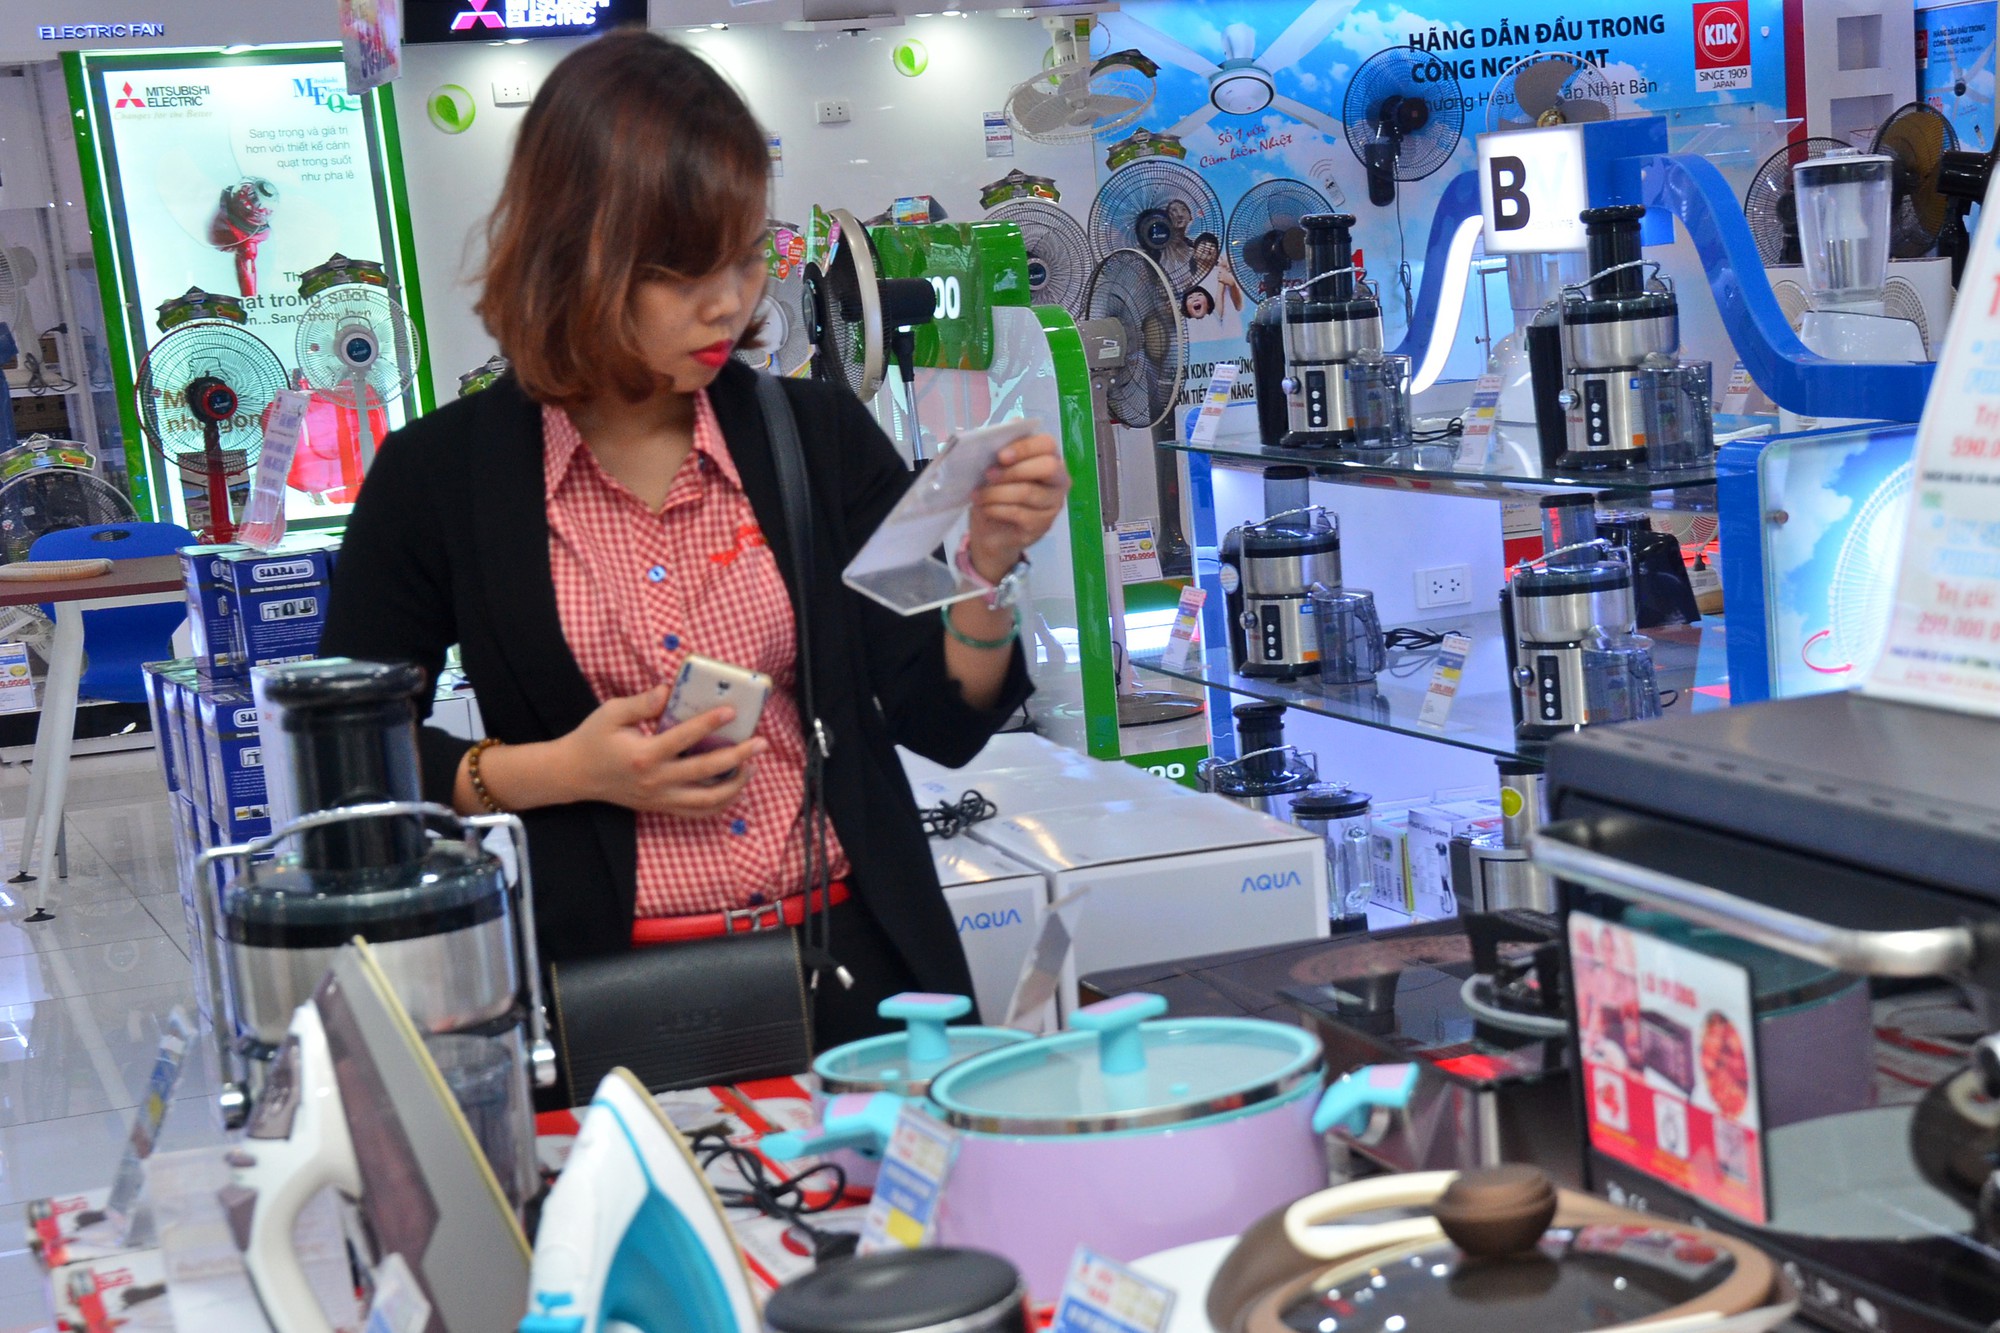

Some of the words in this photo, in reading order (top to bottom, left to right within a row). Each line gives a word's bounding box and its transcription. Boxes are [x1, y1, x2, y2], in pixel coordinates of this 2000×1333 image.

[39, 24, 127, 40] ELECTRIC
[129, 23, 165, 37] FAN
[1409, 27, 1476, 52] HÃNG
[1482, 18, 1530, 48] DẪN
[1535, 16, 1582, 43] ĐẦU
[1588, 14, 1666, 39] TRONG
[1705, 23, 1738, 46] KDK
[1411, 56, 1476, 83] CÔNG
[1700, 70, 1725, 81] SINCE
[1728, 68, 1748, 79] 1909
[146, 85, 210, 97] MITSUBISHI
[1589, 80, 1625, 98] Nhật
[1630, 78, 1658, 94] Bản
[1713, 80, 1736, 89] JAPAN
[148, 96, 203, 108] ELECTRIC
[249, 129, 276, 140] Sang
[278, 128, 304, 139] trọng
[307, 127, 319, 136] và
[321, 127, 336, 138] giá
[339, 126, 348, 136] trị
[1236, 128, 1242, 139] 1
[246, 144, 266, 154] hơn
[269, 143, 285, 153] với
[287, 141, 308, 152] thiết
[311, 140, 323, 151] kế
[326, 140, 350, 150] cánh
[1259, 134, 1292, 152] Nhiệt
[277, 158, 298, 169] quạt
[302, 157, 328, 168] trong
[331, 155, 352, 165] suốt
[301, 171, 321, 181] như
[324, 171, 343, 182] pha
[345, 170, 354, 179] lê
[1489, 156, 1531, 231] B
[1191, 363, 1208, 379] KDK
[1241, 871, 1301, 893] AQUA
[958, 908, 1022, 932] AQUA
